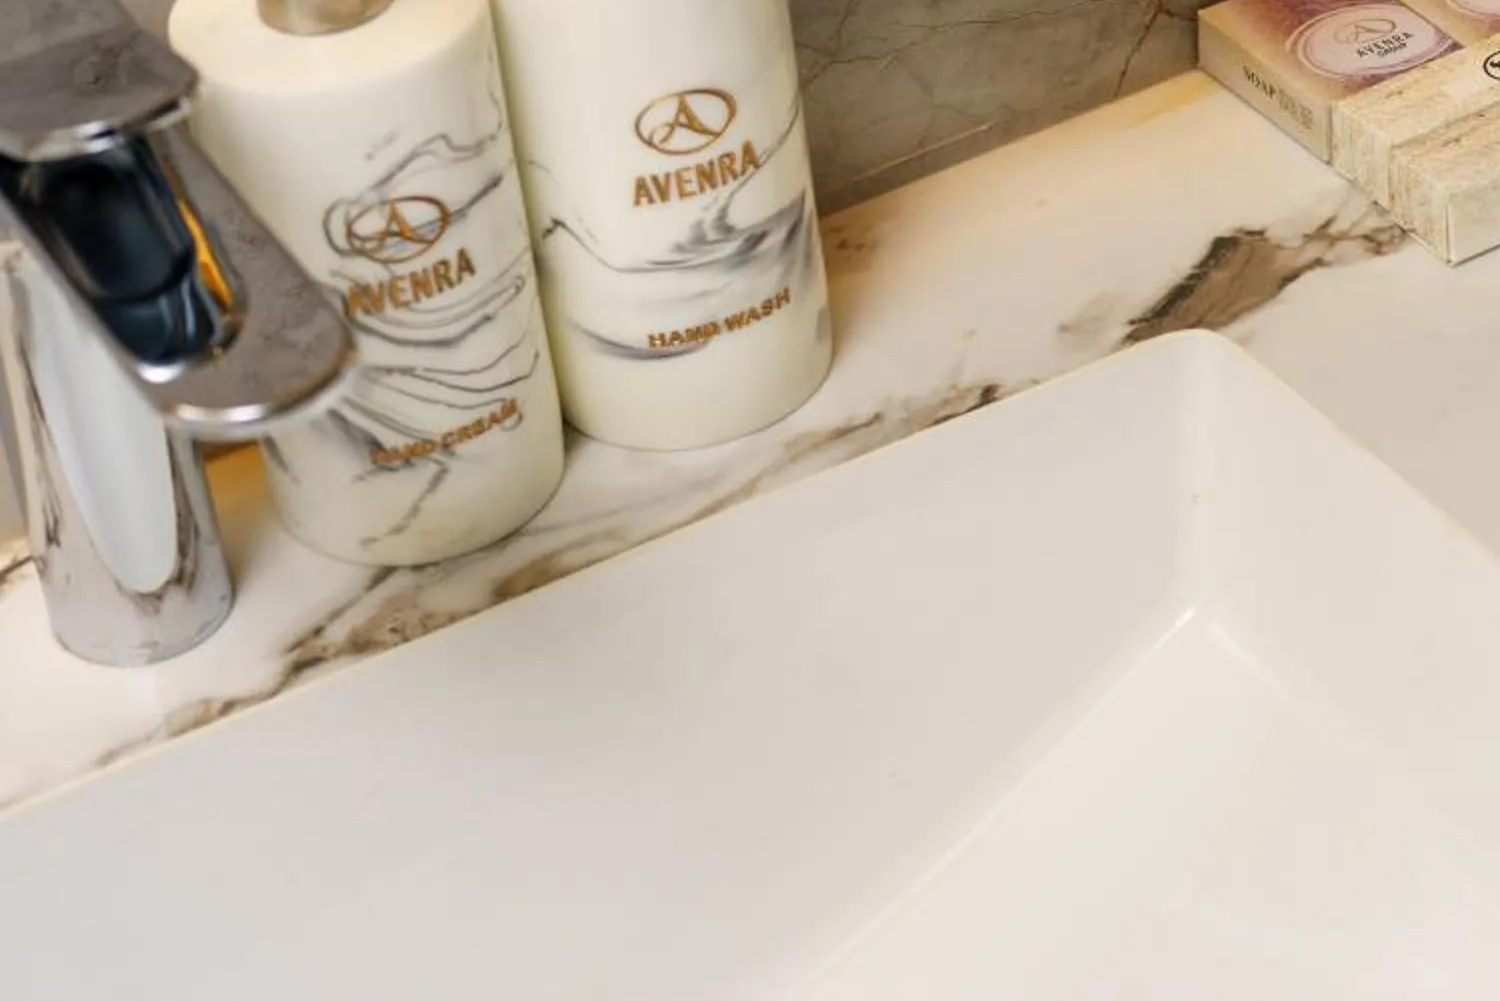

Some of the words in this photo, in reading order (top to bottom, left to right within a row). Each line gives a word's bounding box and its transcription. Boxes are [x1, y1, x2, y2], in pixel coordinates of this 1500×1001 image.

[1356, 31, 1415, 58] AVENRA
[633, 139, 761, 207] AVENRA
[347, 248, 477, 318] AVENRA
[647, 321, 721, 349] HAND
[723, 287, 792, 331] WASH
[440, 398, 520, 449] CREAM
